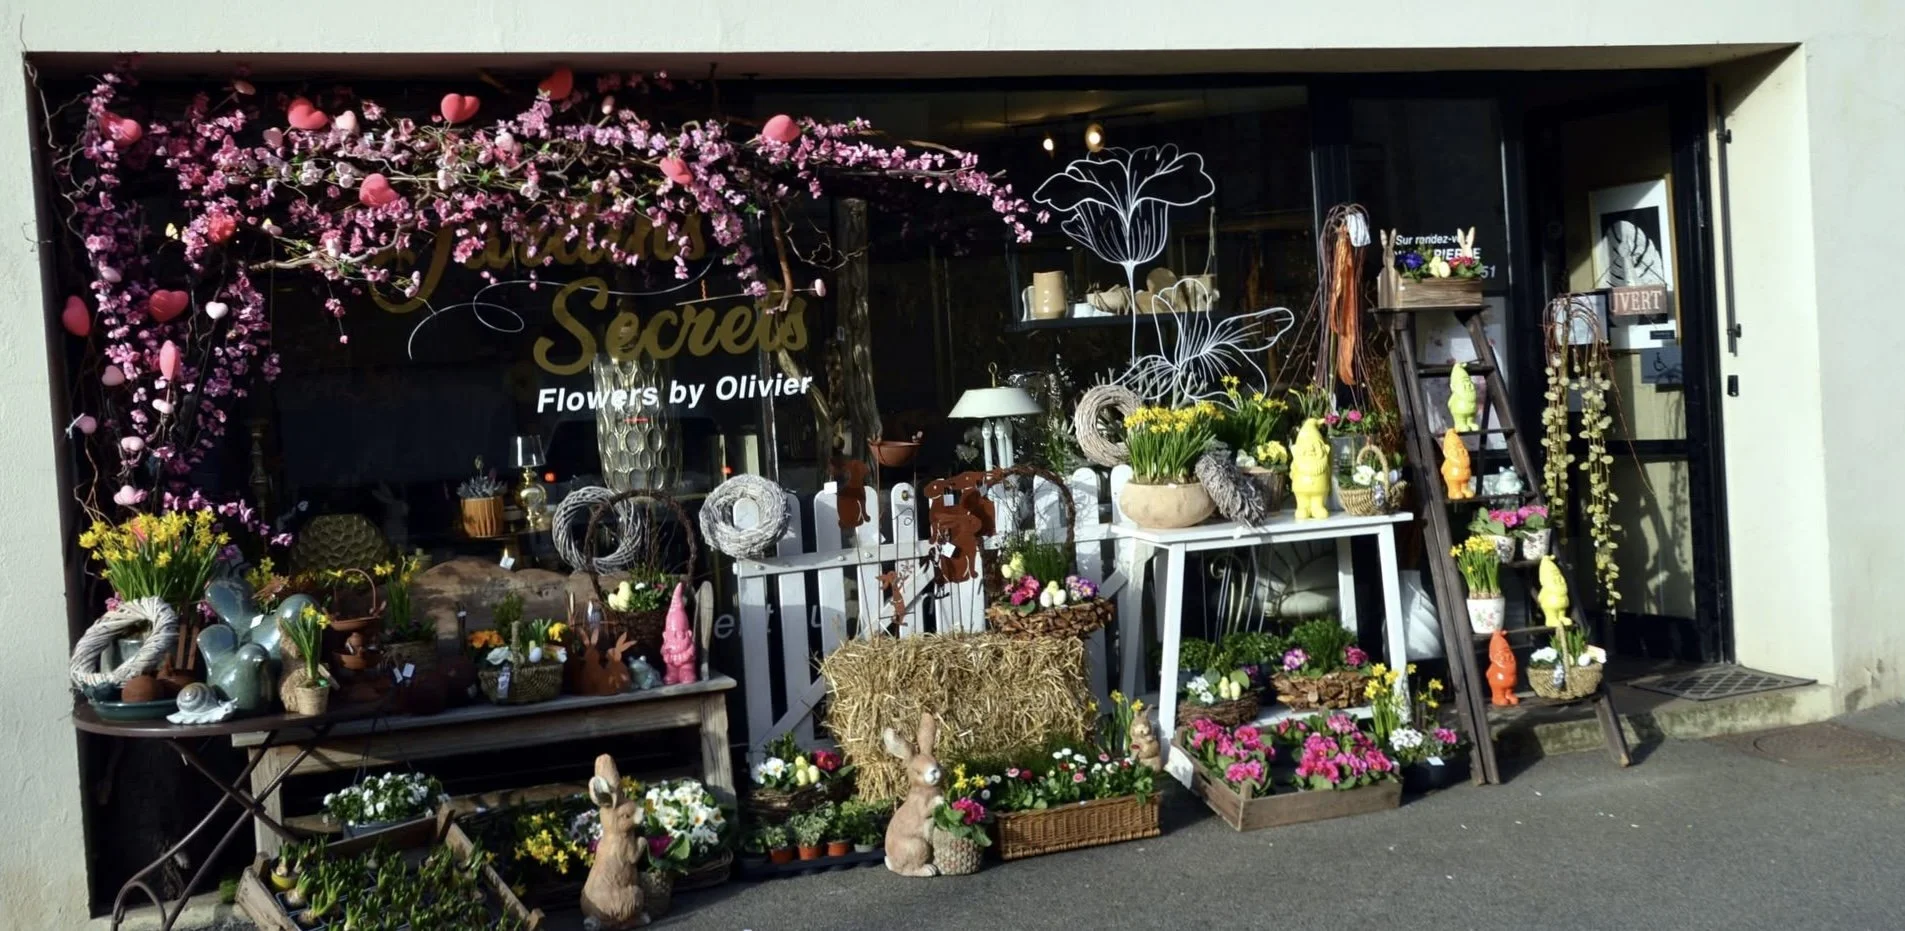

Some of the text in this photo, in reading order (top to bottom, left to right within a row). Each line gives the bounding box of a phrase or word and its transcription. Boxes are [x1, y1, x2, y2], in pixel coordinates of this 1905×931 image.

[1395, 234, 1460, 246] Sur rendez-v
[1433, 247, 1481, 260] PIERE
[1609, 290, 1662, 313] UVERT
[533, 277, 808, 376] Secrets
[537, 372, 813, 413] Flowers by Olivier
